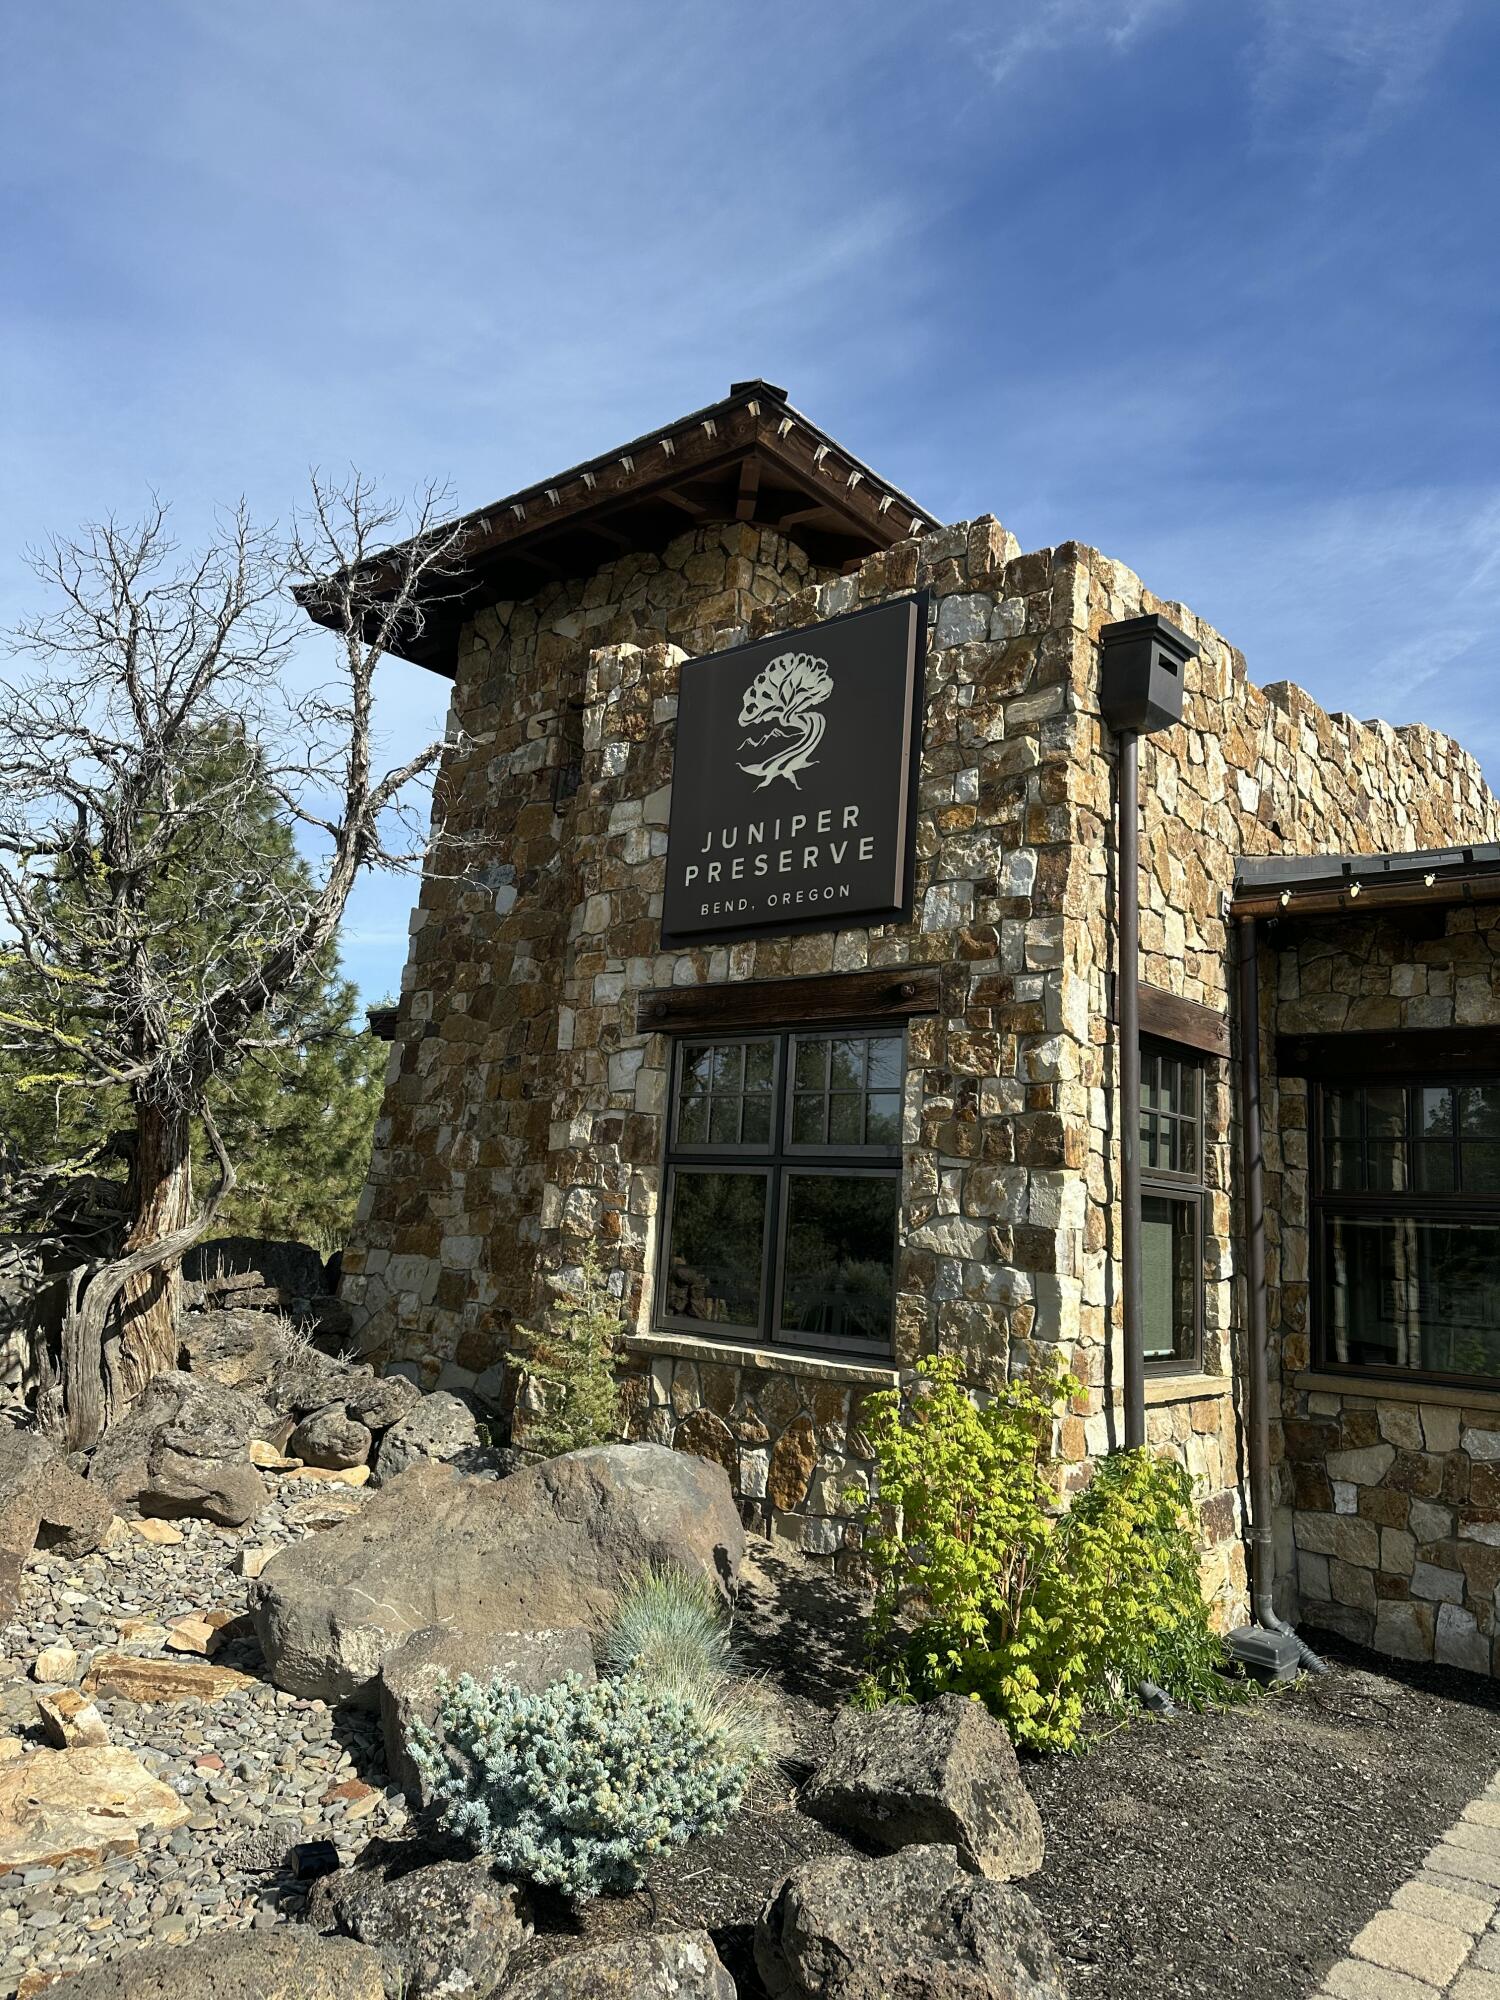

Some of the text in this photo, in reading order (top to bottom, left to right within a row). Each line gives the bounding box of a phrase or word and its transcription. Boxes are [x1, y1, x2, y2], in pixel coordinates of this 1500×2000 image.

[701, 805, 860, 853] JUNIPER
[685, 836, 874, 887] PRESERVE
[701, 884, 850, 916] BEND, OREGON
